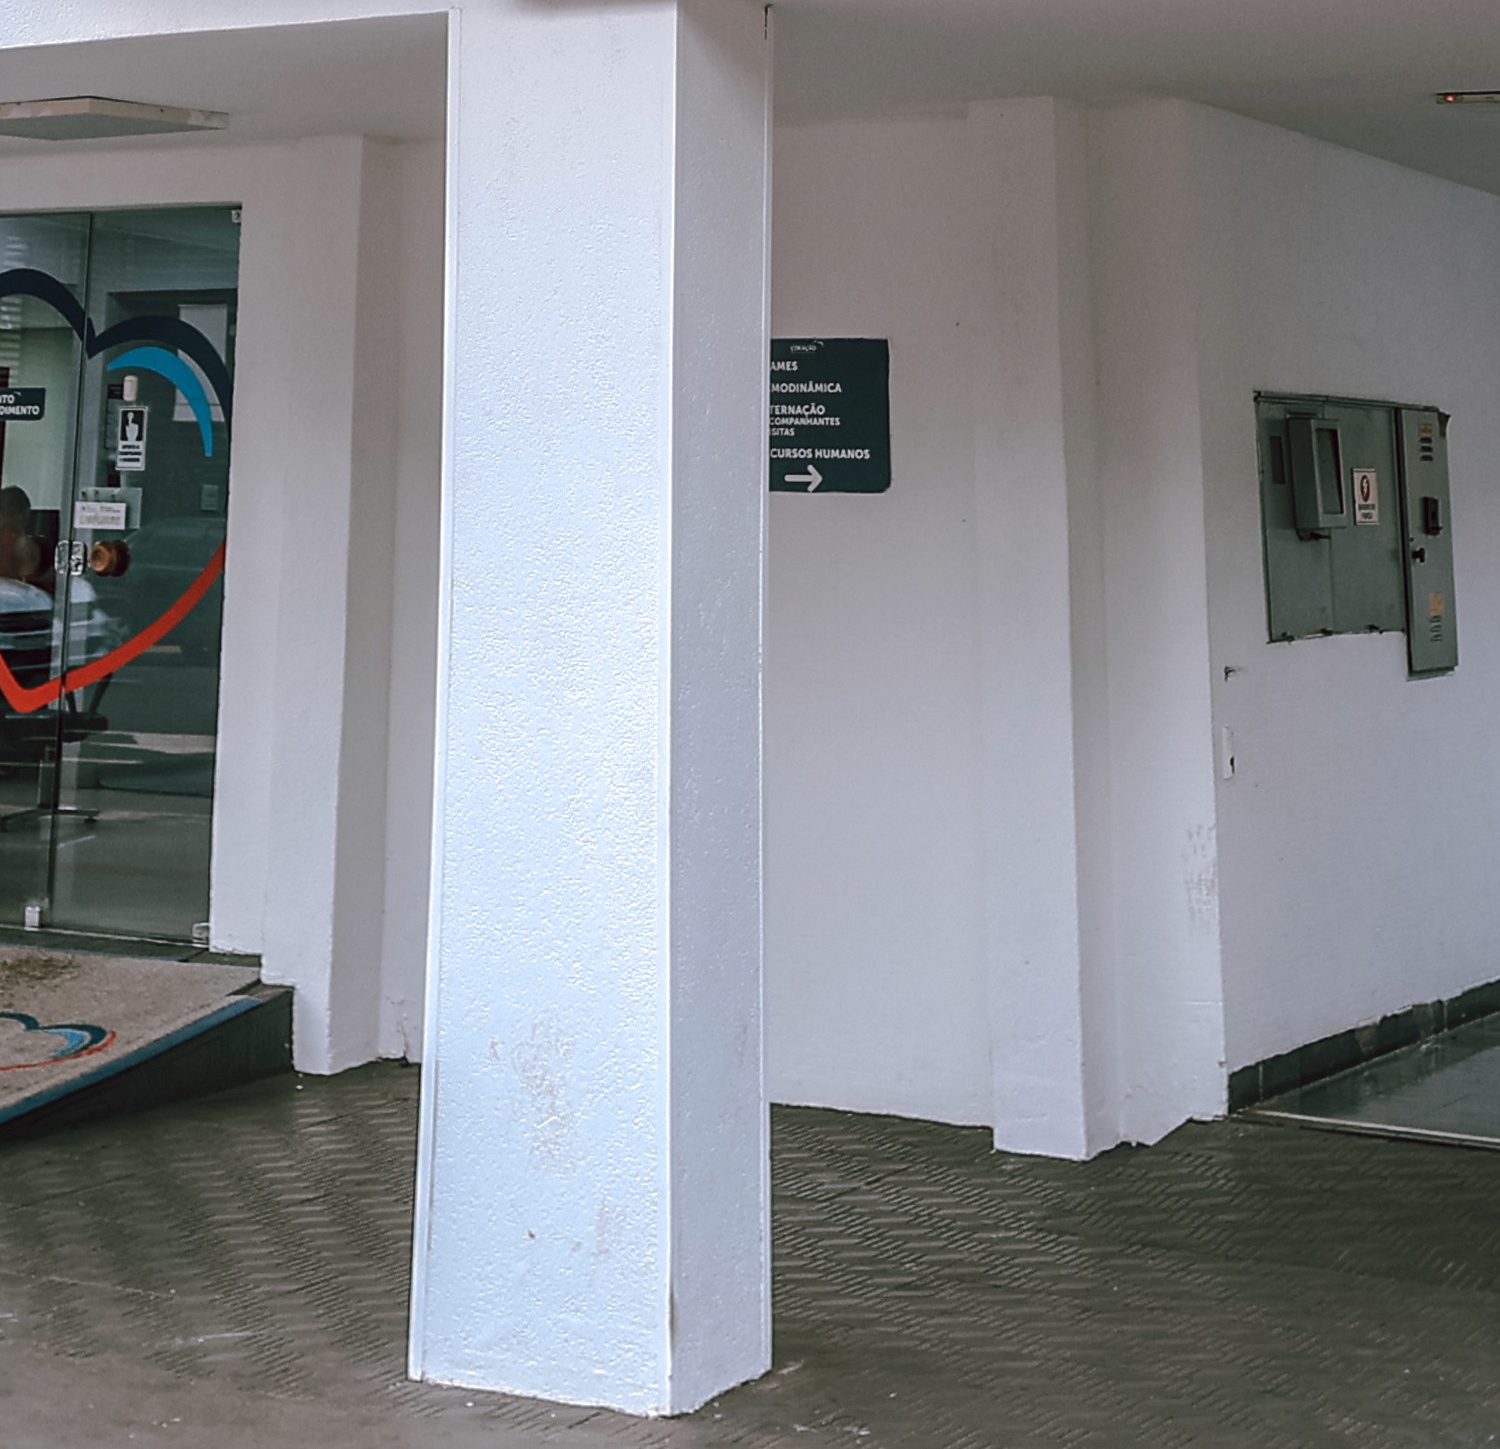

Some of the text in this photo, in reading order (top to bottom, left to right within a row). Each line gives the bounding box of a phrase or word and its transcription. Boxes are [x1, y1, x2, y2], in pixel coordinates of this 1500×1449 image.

[770, 361, 798, 372] AMES
[770, 380, 842, 393] MODINÂMICA
[770, 402, 826, 417] TERNAÇÃO
[770, 448, 871, 460] CURSOS HUMANOS
